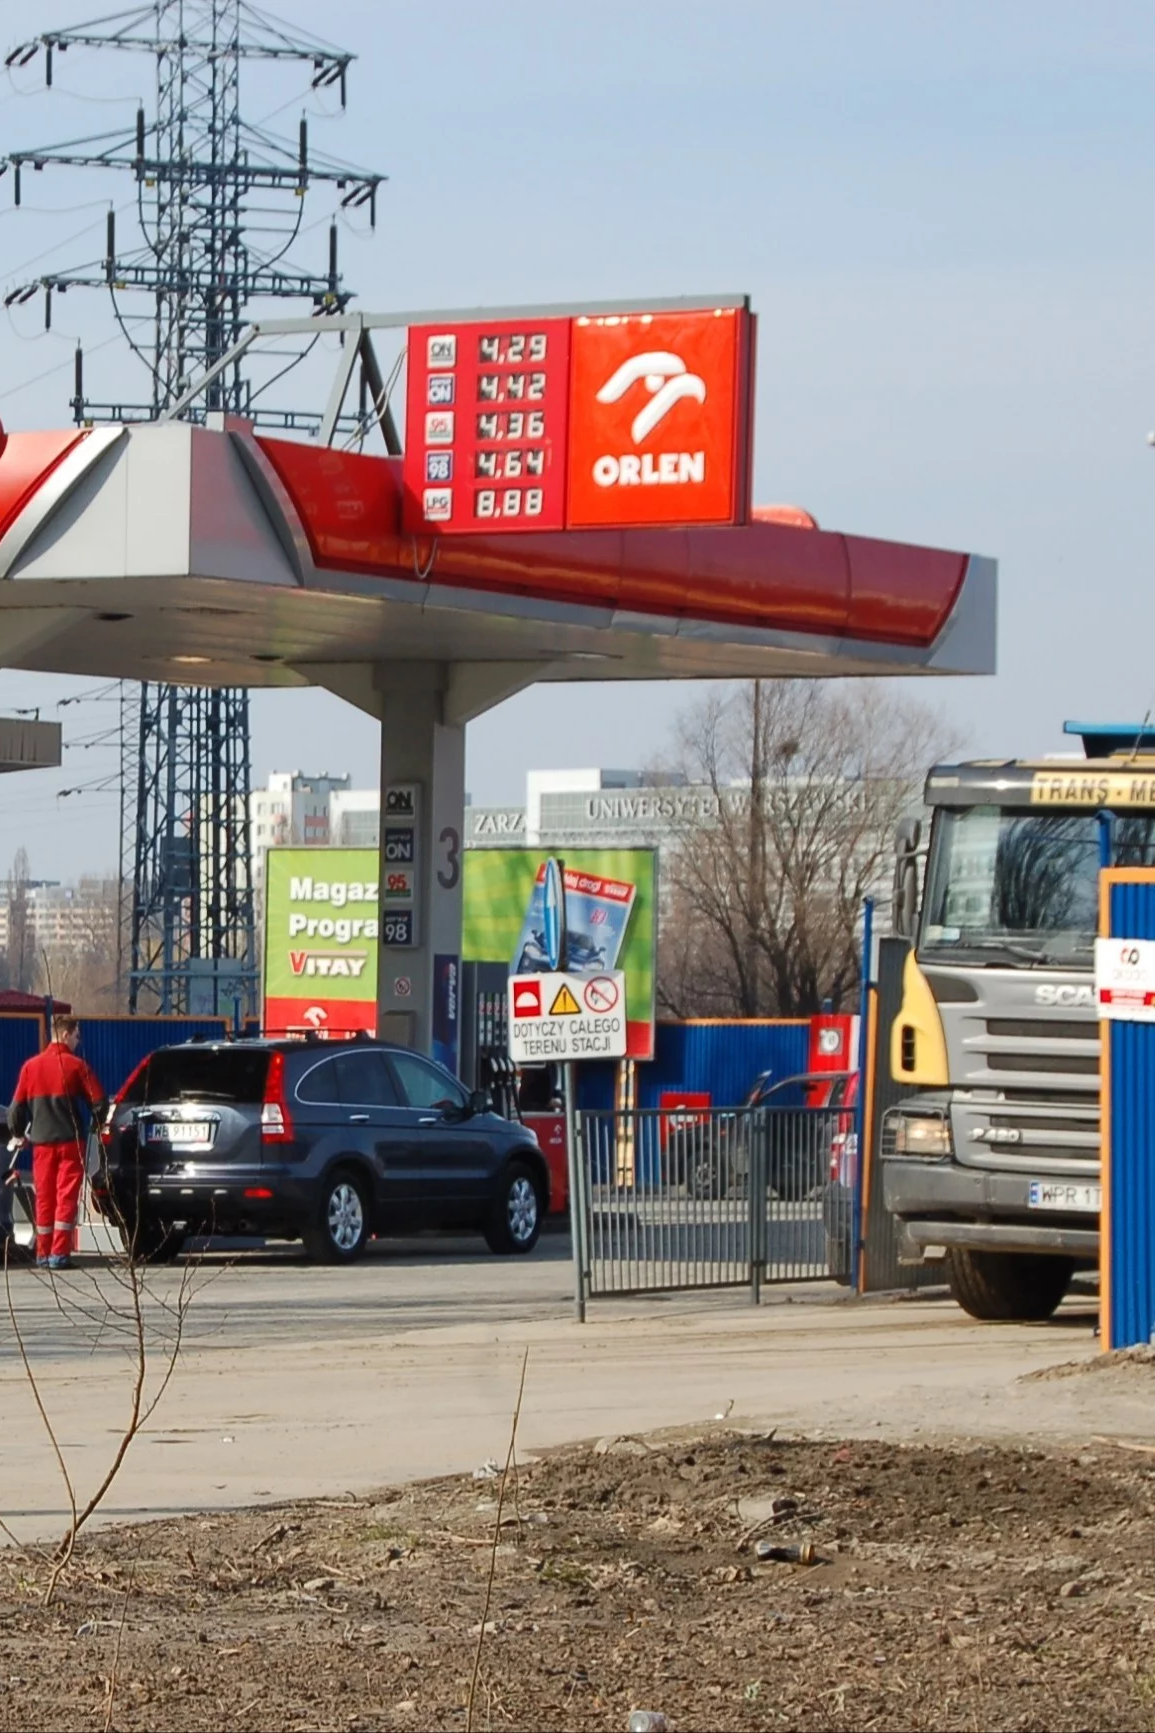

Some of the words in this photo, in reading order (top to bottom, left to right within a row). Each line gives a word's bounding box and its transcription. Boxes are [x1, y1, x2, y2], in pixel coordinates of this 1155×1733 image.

[480, 334, 547, 365] 4,29
[480, 372, 546, 403] 4,42
[478, 411, 545, 441] 4,36
[428, 462, 449, 479] 98
[478, 450, 545, 480] 4,64
[593, 451, 706, 488] ORLEN
[476, 488, 544, 518] 8,88
[386, 791, 412, 808] ON
[1038, 778, 1109, 801] TRANS
[386, 843, 411, 859] ON
[437, 827, 460, 890] 3
[289, 877, 379, 907] Magaz
[388, 874, 407, 892] 95
[289, 914, 378, 943] Progra
[385, 924, 407, 941] 98
[289, 952, 366, 976] VITAY
[513, 1022, 565, 1039] DOTYCZY
[569, 1018, 620, 1035] CAŁEGO
[523, 1038, 566, 1055] TERENU
[571, 1037, 611, 1052] STACJI
[1042, 1186, 1077, 1203] WPR
